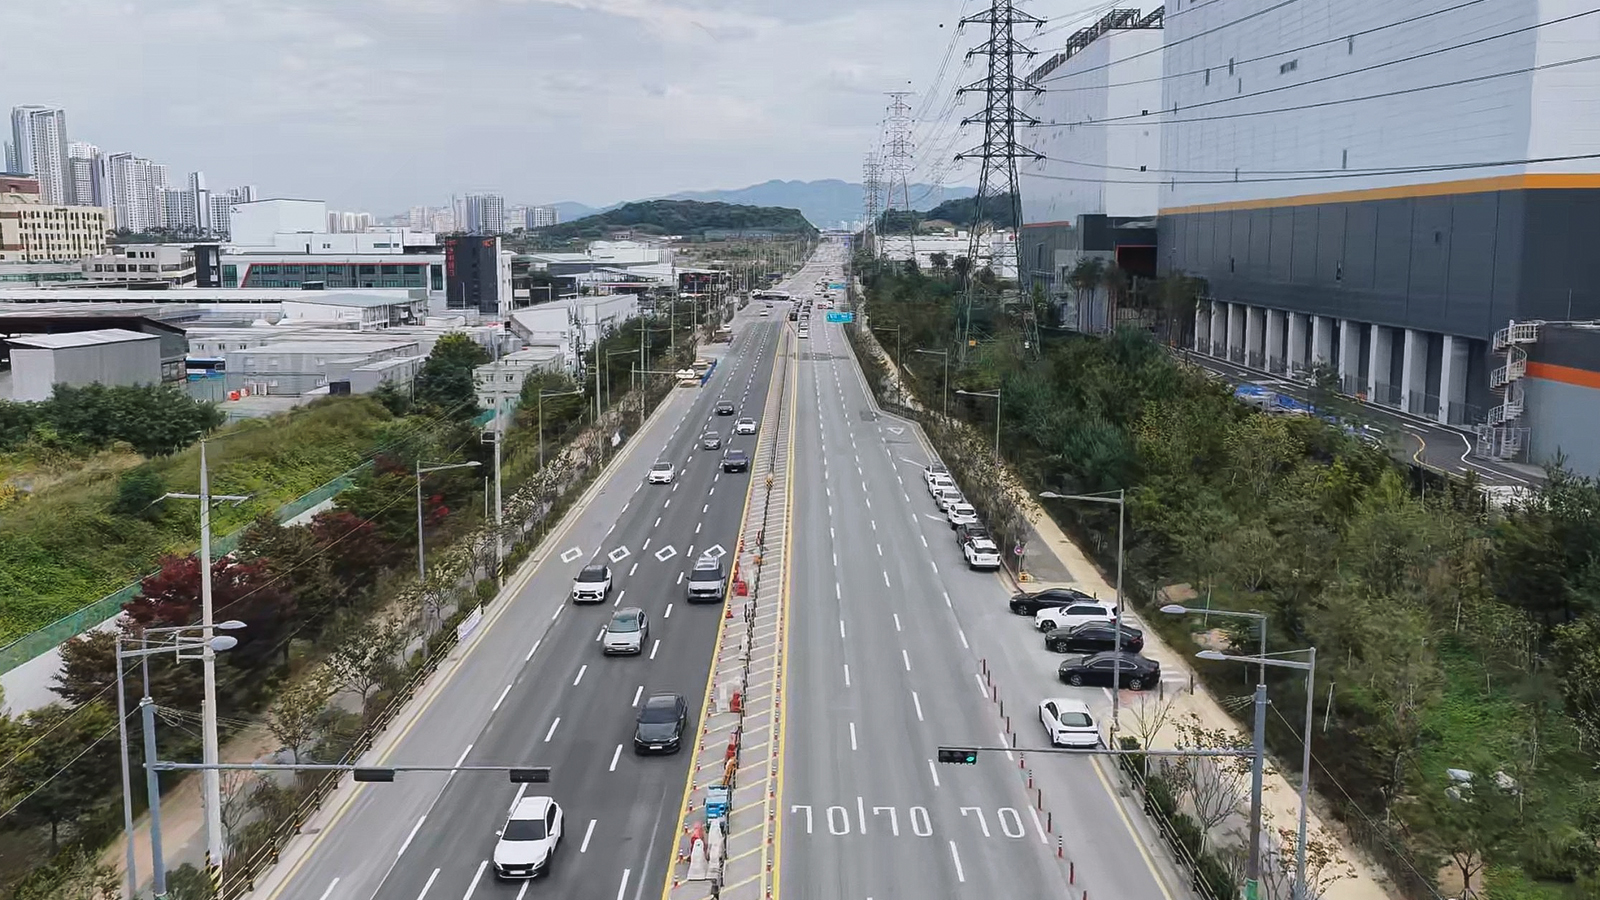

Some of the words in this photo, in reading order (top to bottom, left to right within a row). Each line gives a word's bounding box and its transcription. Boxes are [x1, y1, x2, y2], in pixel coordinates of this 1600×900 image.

[791, 805, 850, 835] 70
[873, 806, 933, 837] 70
[960, 807, 1025, 838] 70
